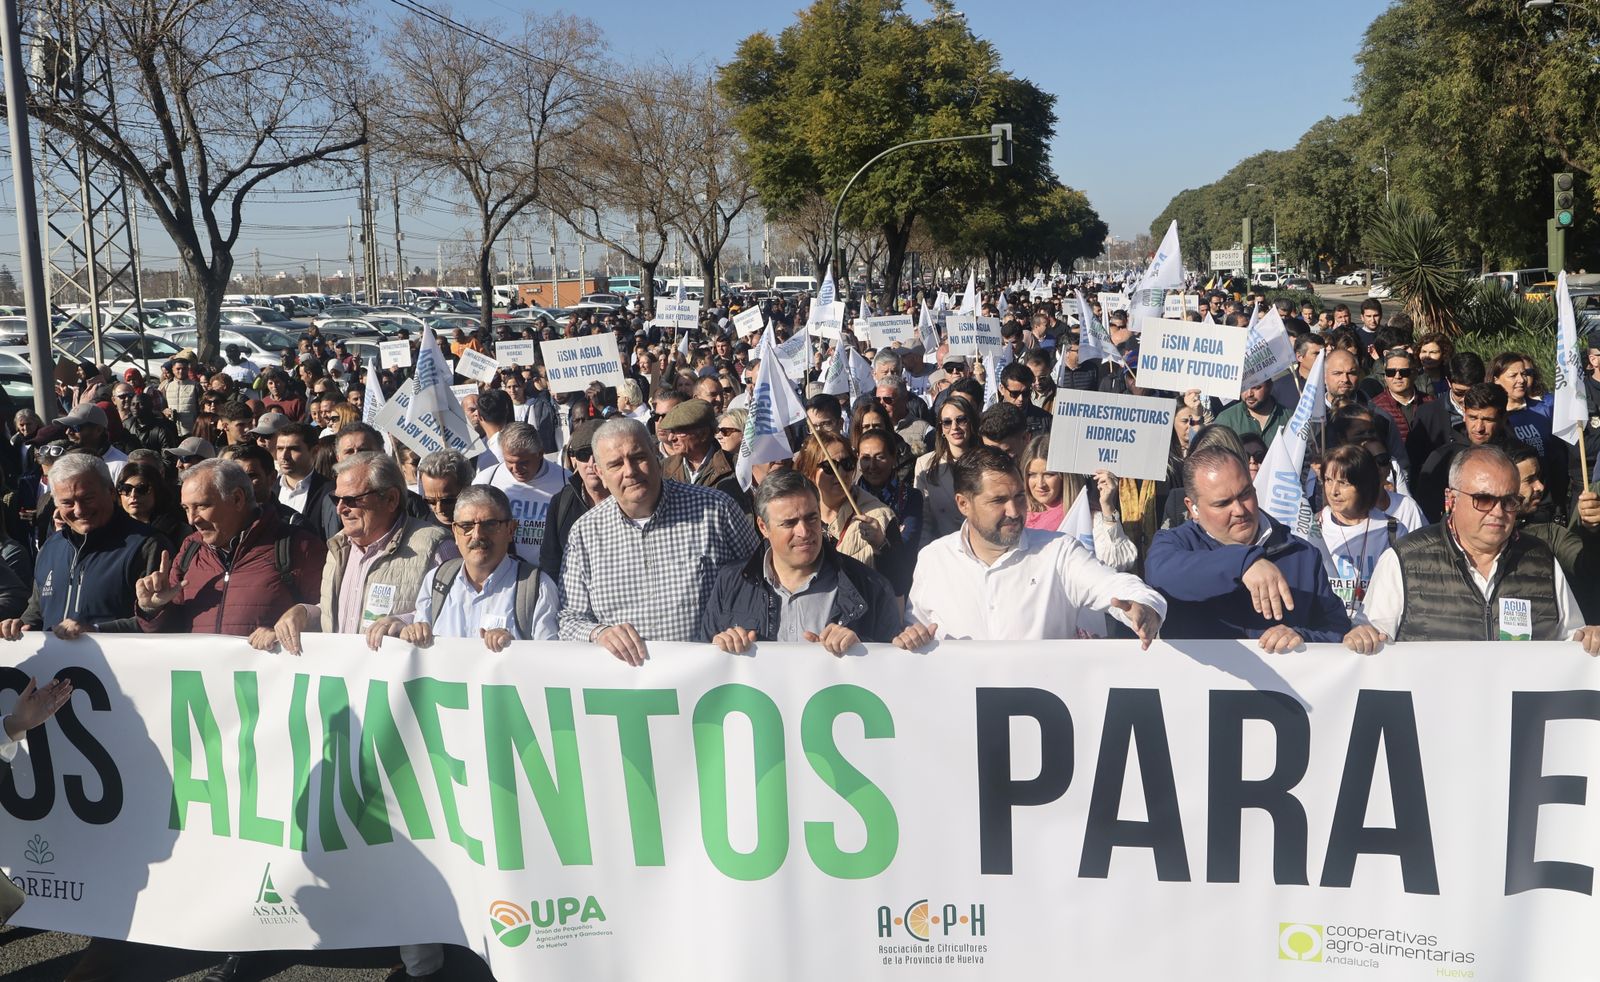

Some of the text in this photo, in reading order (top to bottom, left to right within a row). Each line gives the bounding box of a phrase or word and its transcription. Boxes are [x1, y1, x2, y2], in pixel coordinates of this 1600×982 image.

[950, 335, 959, 344] NO
[961, 335, 973, 344] HAY
[1161, 333, 1223, 355] ¡¡SIN AGUA
[557, 345, 603, 362] ¡¡SIN AGUA
[549, 361, 619, 380] NO HAY FUTURO!!
[1141, 354, 1238, 381] NO HAY FUTURO!!
[1057, 401, 1170, 425] ¡¡INFRAESTRUCTURAS
[1085, 425, 1136, 443] HIDRICAS
[1514, 424, 1540, 440] GUA
[1098, 448, 1118, 463] YA!!
[1504, 600, 1527, 612] AGUA
[169, 670, 899, 879] ALIMENTOS
[976, 687, 1440, 895] PARA
[252, 905, 299, 917] ASAJA
[531, 895, 607, 928] UPA
[260, 916, 298, 925] HUELVA
[563, 924, 593, 932] Pequeños
[536, 934, 574, 943] Agricultores
[579, 930, 613, 938] Ganaderos
[1326, 925, 1438, 947] cooperativas
[878, 943, 988, 954] Asociación de Citricultores
[1326, 938, 1475, 964] agro-alimentarias
[882, 954, 984, 965] de la Provincia de Huelva
[1326, 955, 1380, 969] Andalucía
[1436, 967, 1474, 978] Huelva
